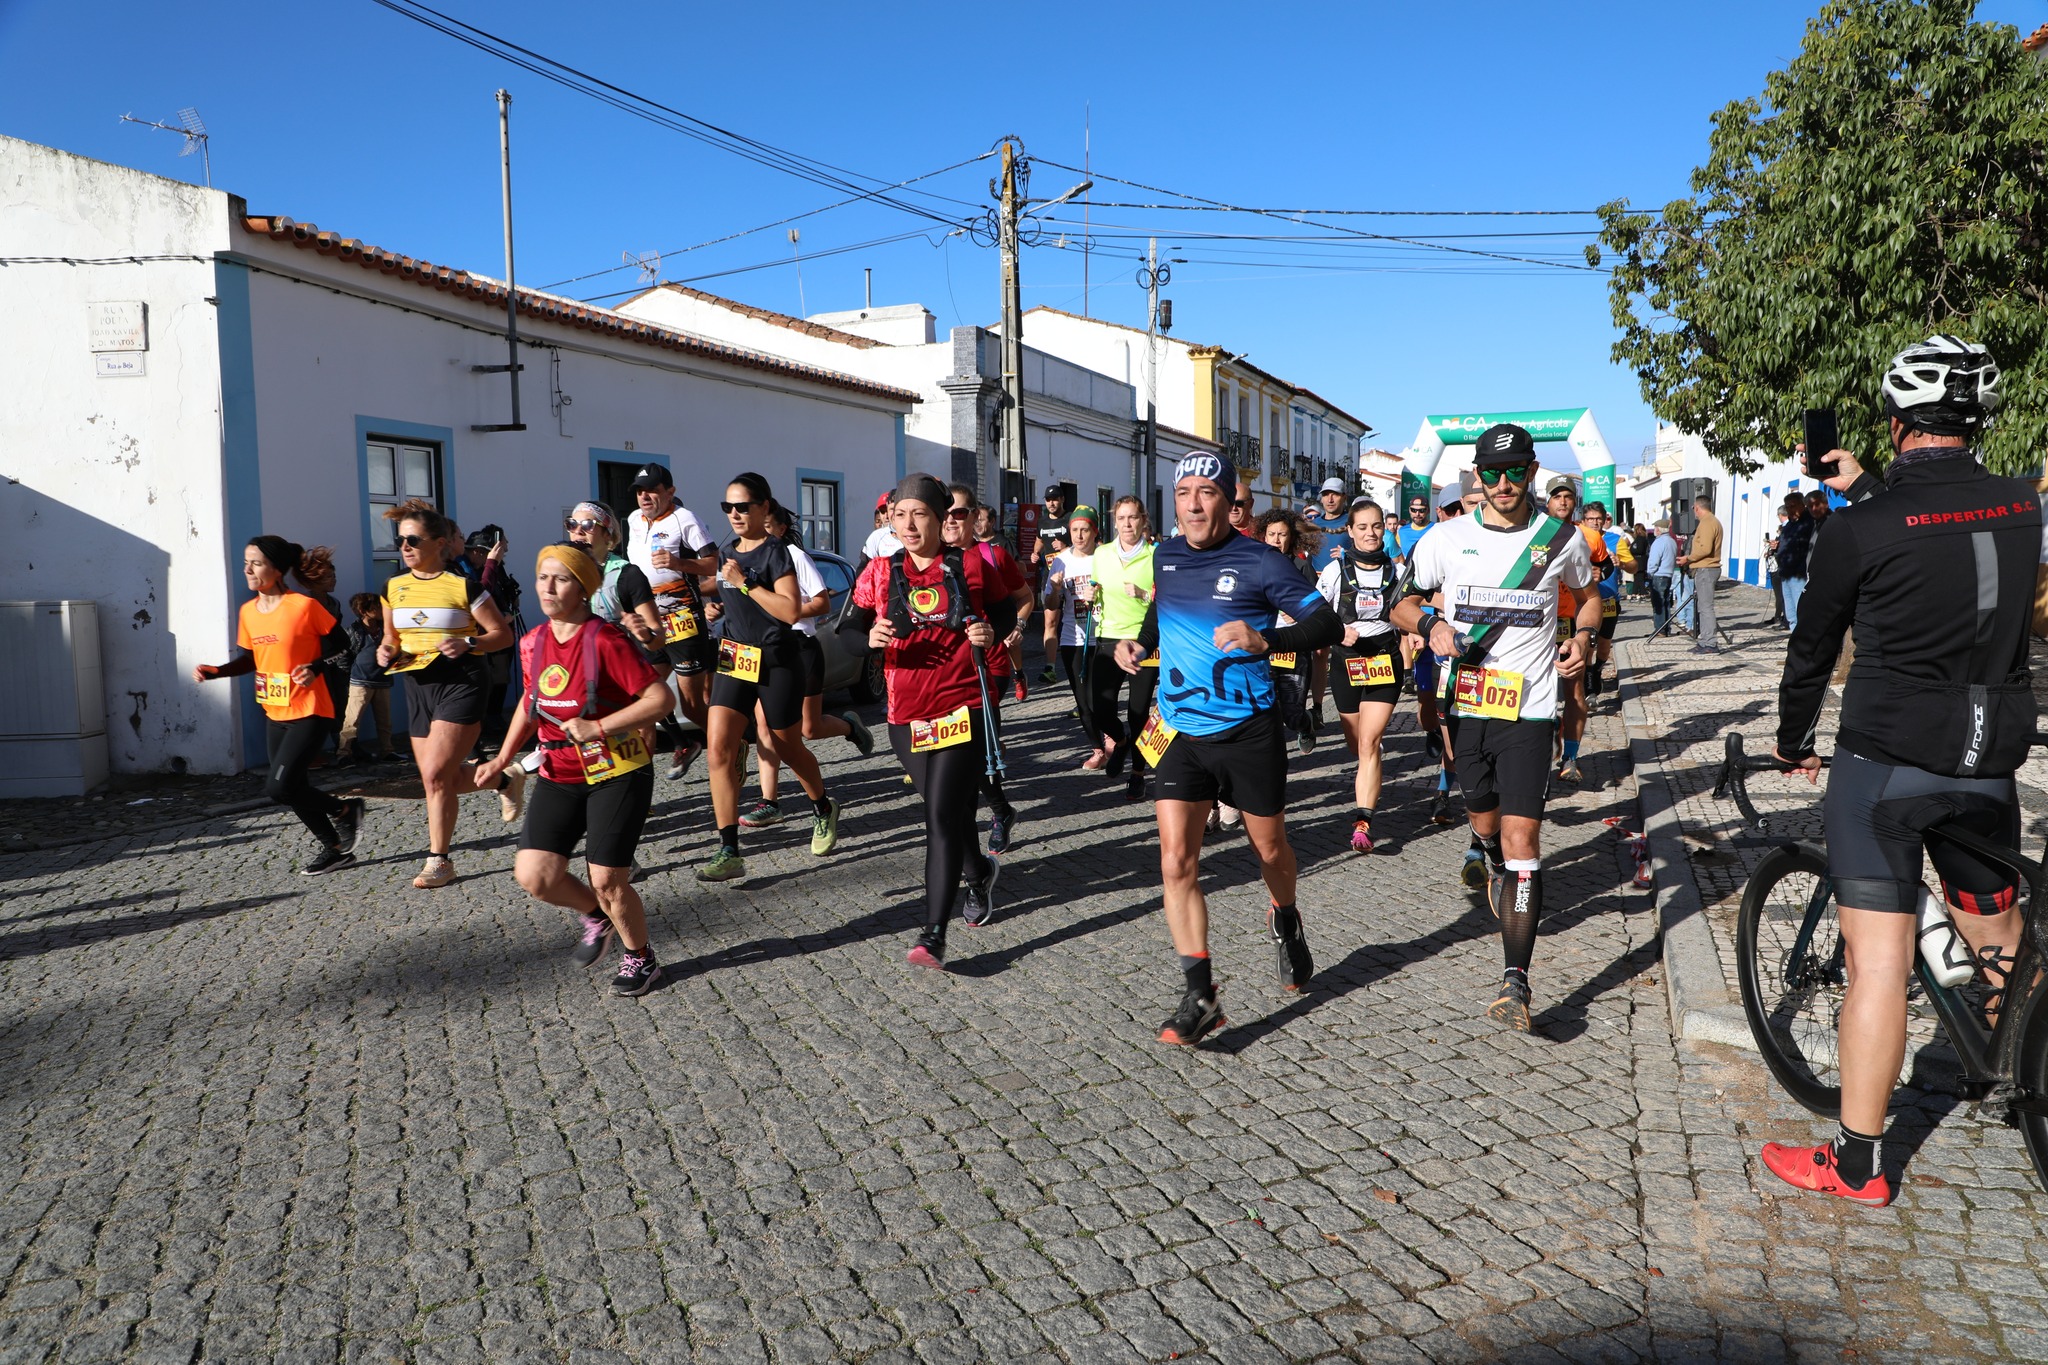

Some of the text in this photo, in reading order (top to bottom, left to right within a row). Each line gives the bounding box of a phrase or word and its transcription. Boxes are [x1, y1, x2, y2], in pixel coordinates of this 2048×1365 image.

[1463, 416, 1488, 432] CA
[624, 440, 634, 451] 23
[1412, 480, 1426, 490] CA
[1596, 475, 1611, 485] CA
[1905, 500, 2037, 527] DESPERTAR S.C.
[1472, 589, 1545, 607] institutoptico
[1483, 617, 1505, 625] Alvito
[1495, 610, 1519, 619] Castro
[674, 618, 695, 633] 125
[737, 656, 758, 673] 331
[1275, 652, 1296, 663] 089
[1369, 665, 1393, 679] 048
[269, 684, 288, 698] 231
[1485, 686, 1518, 708] 073
[939, 719, 969, 740] 026
[1972, 703, 1984, 750] FORCE
[614, 737, 643, 761] 172
[1149, 728, 1170, 756] 300
[1519, 887, 1531, 913] SPORT
